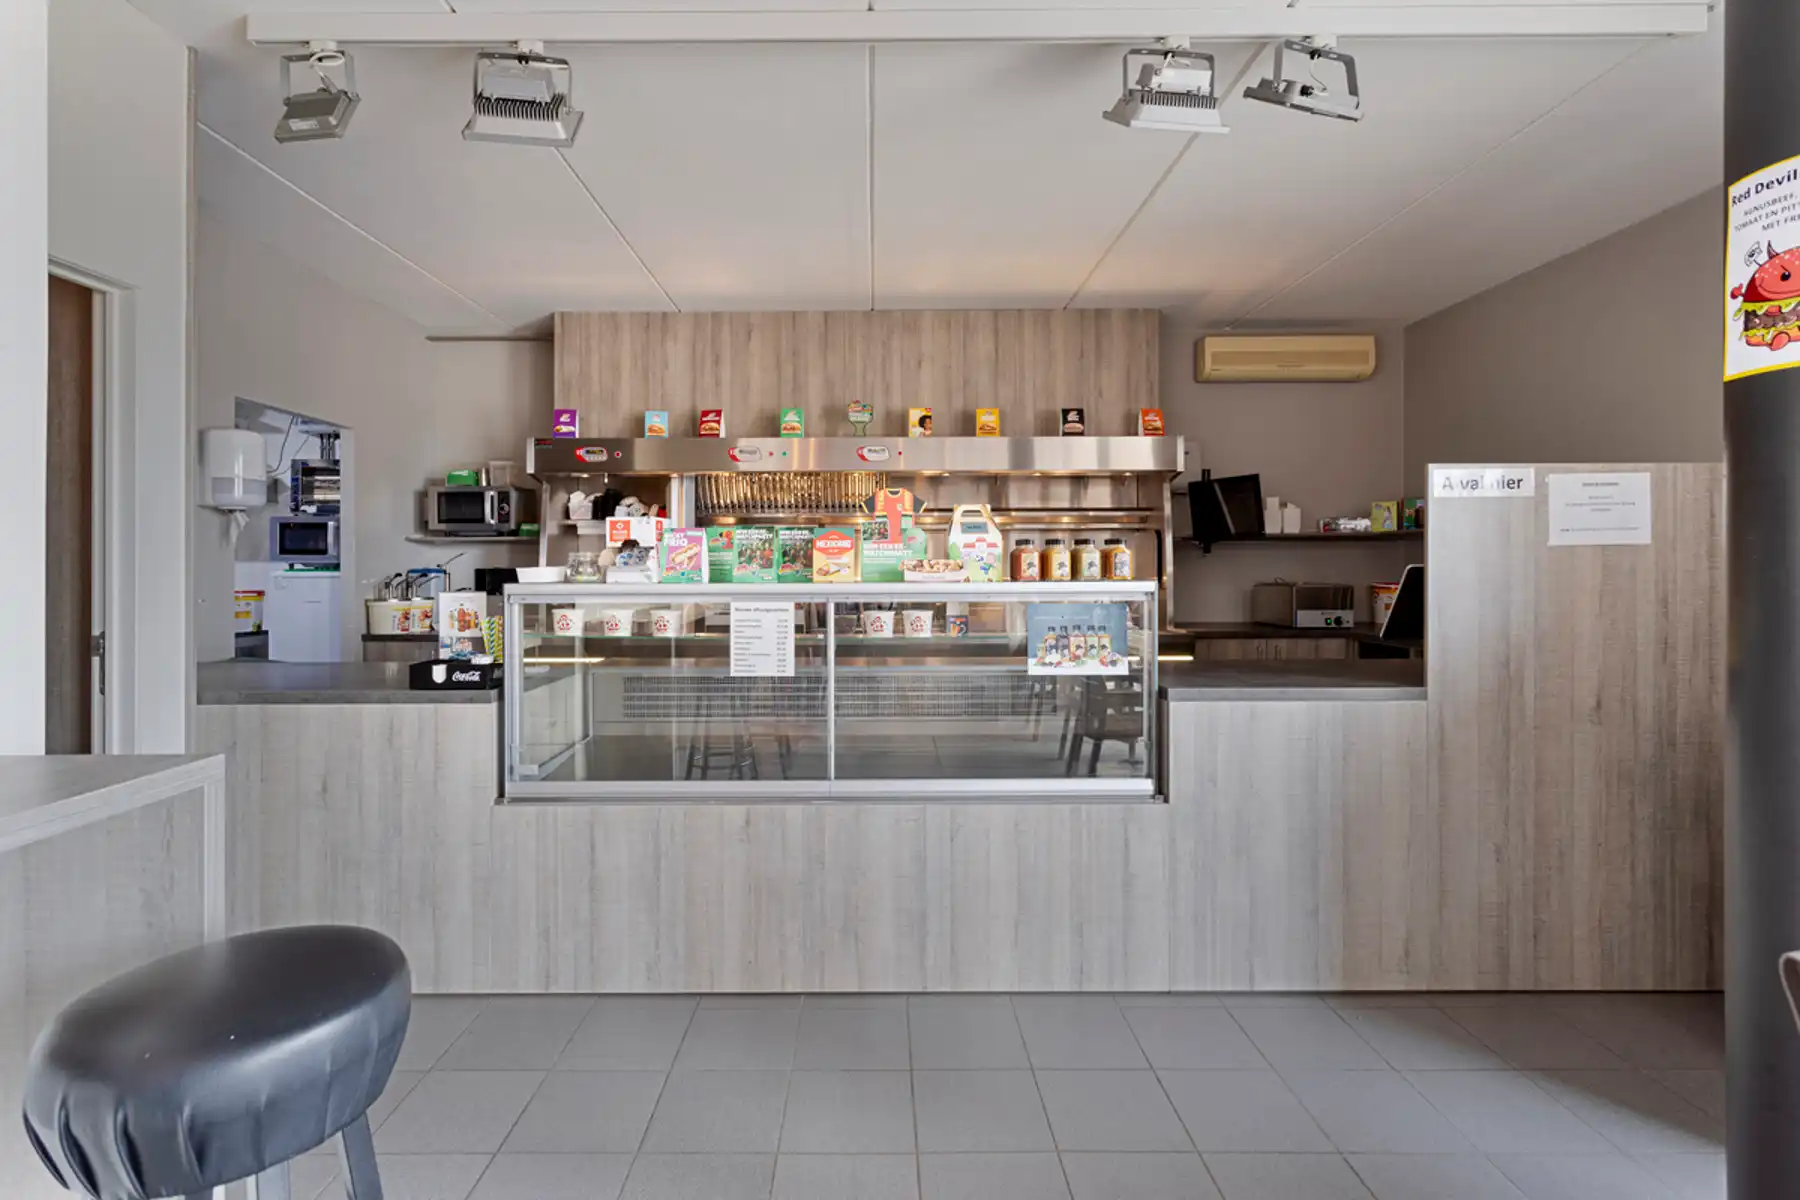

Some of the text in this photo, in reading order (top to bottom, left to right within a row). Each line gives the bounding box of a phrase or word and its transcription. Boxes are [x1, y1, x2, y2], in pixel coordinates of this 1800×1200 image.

[1732, 168, 1798, 207] Red Devil
[1442, 474, 1485, 491] Aval
